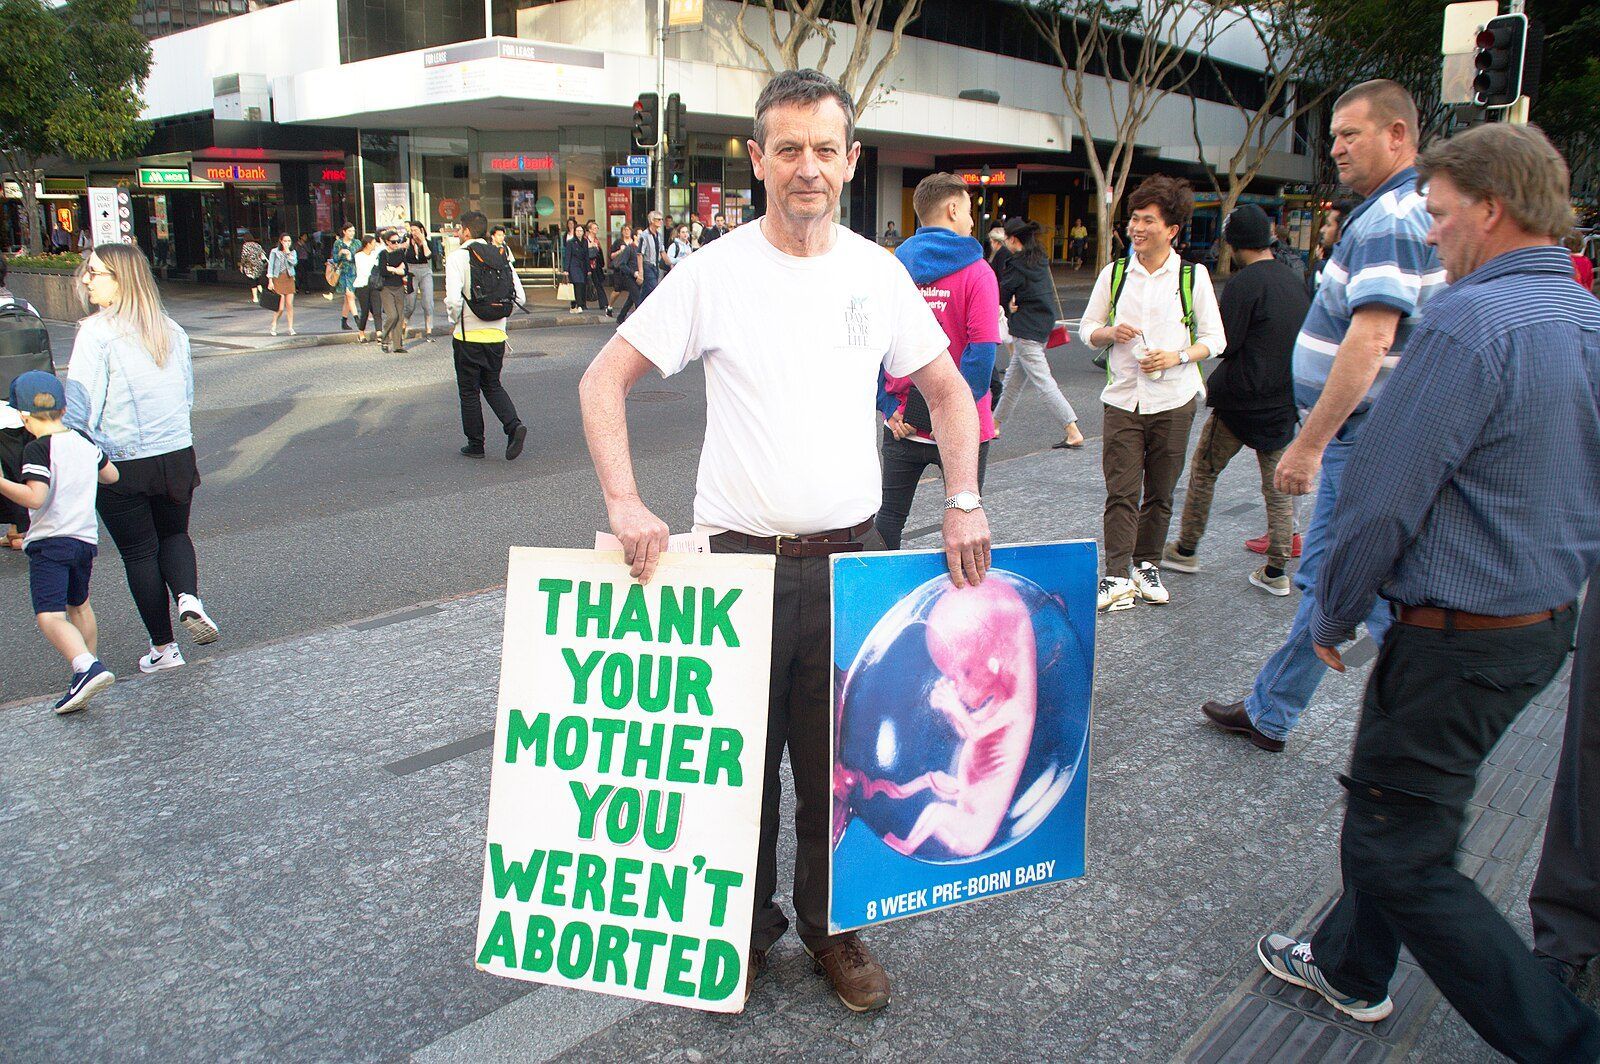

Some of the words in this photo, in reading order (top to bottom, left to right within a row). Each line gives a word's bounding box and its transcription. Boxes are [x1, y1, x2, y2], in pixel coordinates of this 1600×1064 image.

[425, 53, 434, 65] FOR
[434, 51, 447, 63] LEASE
[502, 44, 516, 56] FOR
[516, 45, 535, 59] LEASE
[207, 166, 266, 179] medibank
[491, 155, 554, 171] medibank
[848, 323, 870, 335] FOR
[538, 578, 743, 648] THANK
[561, 647, 714, 717] YOUR
[504, 709, 744, 787] MOTHER
[568, 780, 685, 853] YOU
[489, 843, 744, 927] WEREN'T
[866, 900, 877, 920] 8
[880, 888, 928, 917] WEEK
[932, 869, 1011, 904] PRE-BORN
[1015, 859, 1056, 885] BABY
[476, 910, 741, 1001] ABORTED
